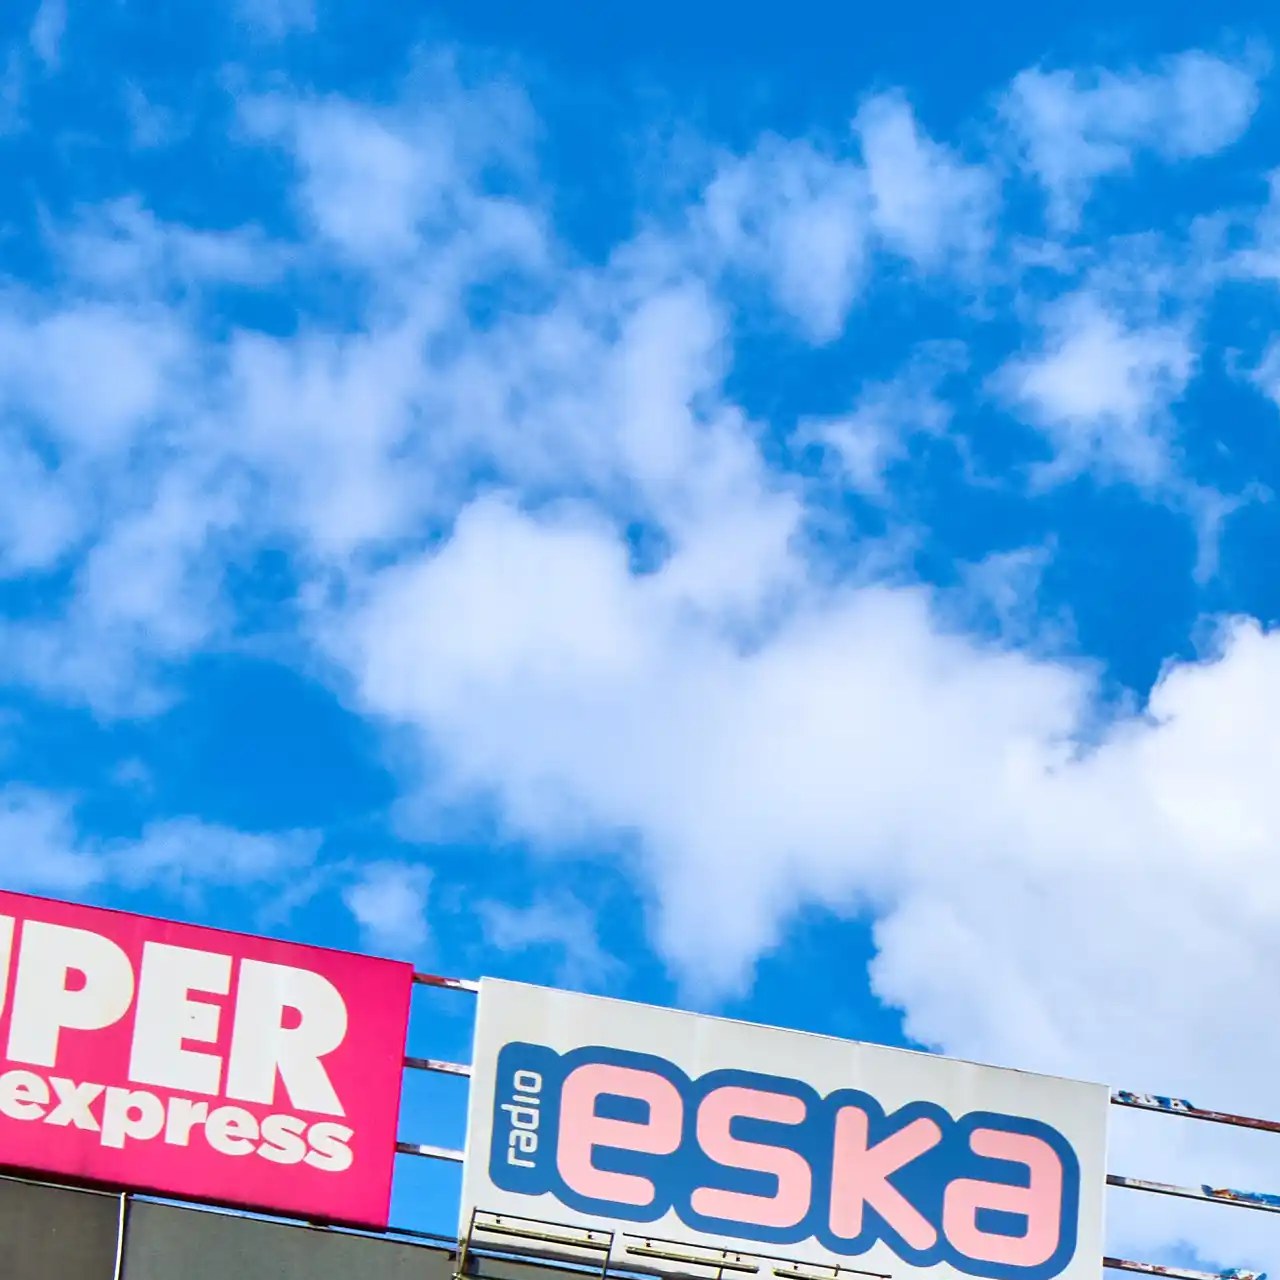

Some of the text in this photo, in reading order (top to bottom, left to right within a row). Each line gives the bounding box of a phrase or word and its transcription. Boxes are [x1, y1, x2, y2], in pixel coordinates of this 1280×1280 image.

[0, 913, 348, 1118] PER
[0, 1068, 354, 1173] express
[501, 1070, 542, 1168] radio
[556, 1062, 1062, 1268] eska
